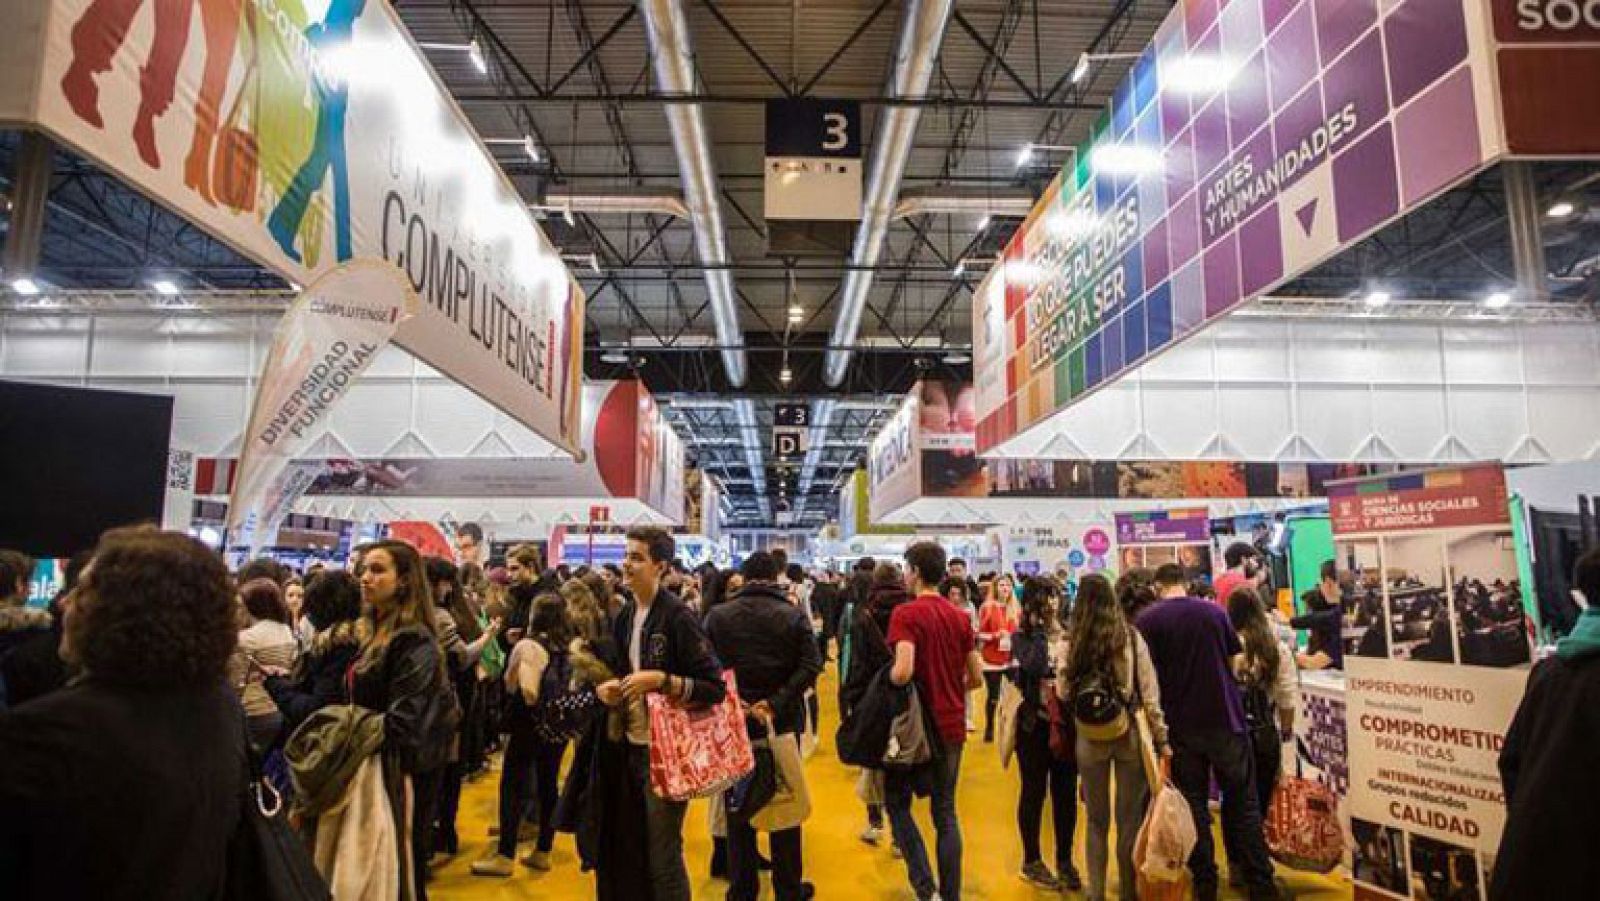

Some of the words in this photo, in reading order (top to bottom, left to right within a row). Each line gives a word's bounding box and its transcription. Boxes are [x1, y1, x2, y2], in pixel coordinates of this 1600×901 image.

[1517, 0, 1600, 29] SOC
[822, 112, 848, 150] 3
[1205, 154, 1252, 212] ARTES
[1206, 213, 1216, 238] Y
[1219, 103, 1357, 228] HUMANIDADES
[1074, 196, 1139, 286] PUEDES
[382, 189, 546, 393] COMPLUTENSE
[310, 300, 388, 323] COMPLUTENSE
[1029, 312, 1078, 370] LLEGAR
[1093, 265, 1126, 318] SER
[259, 341, 349, 446] DIVERSIDAD
[290, 342, 378, 438] FUNCIONAL
[795, 408, 806, 425] 3
[779, 435, 796, 454] D
[1362, 502, 1415, 517] CIENCIAS
[1418, 496, 1480, 511] SOCIALES
[1363, 519, 1373, 529] Y
[1350, 677, 1475, 704] EMPRENDIMIENTO
[1389, 800, 1481, 838] CALIDAD
